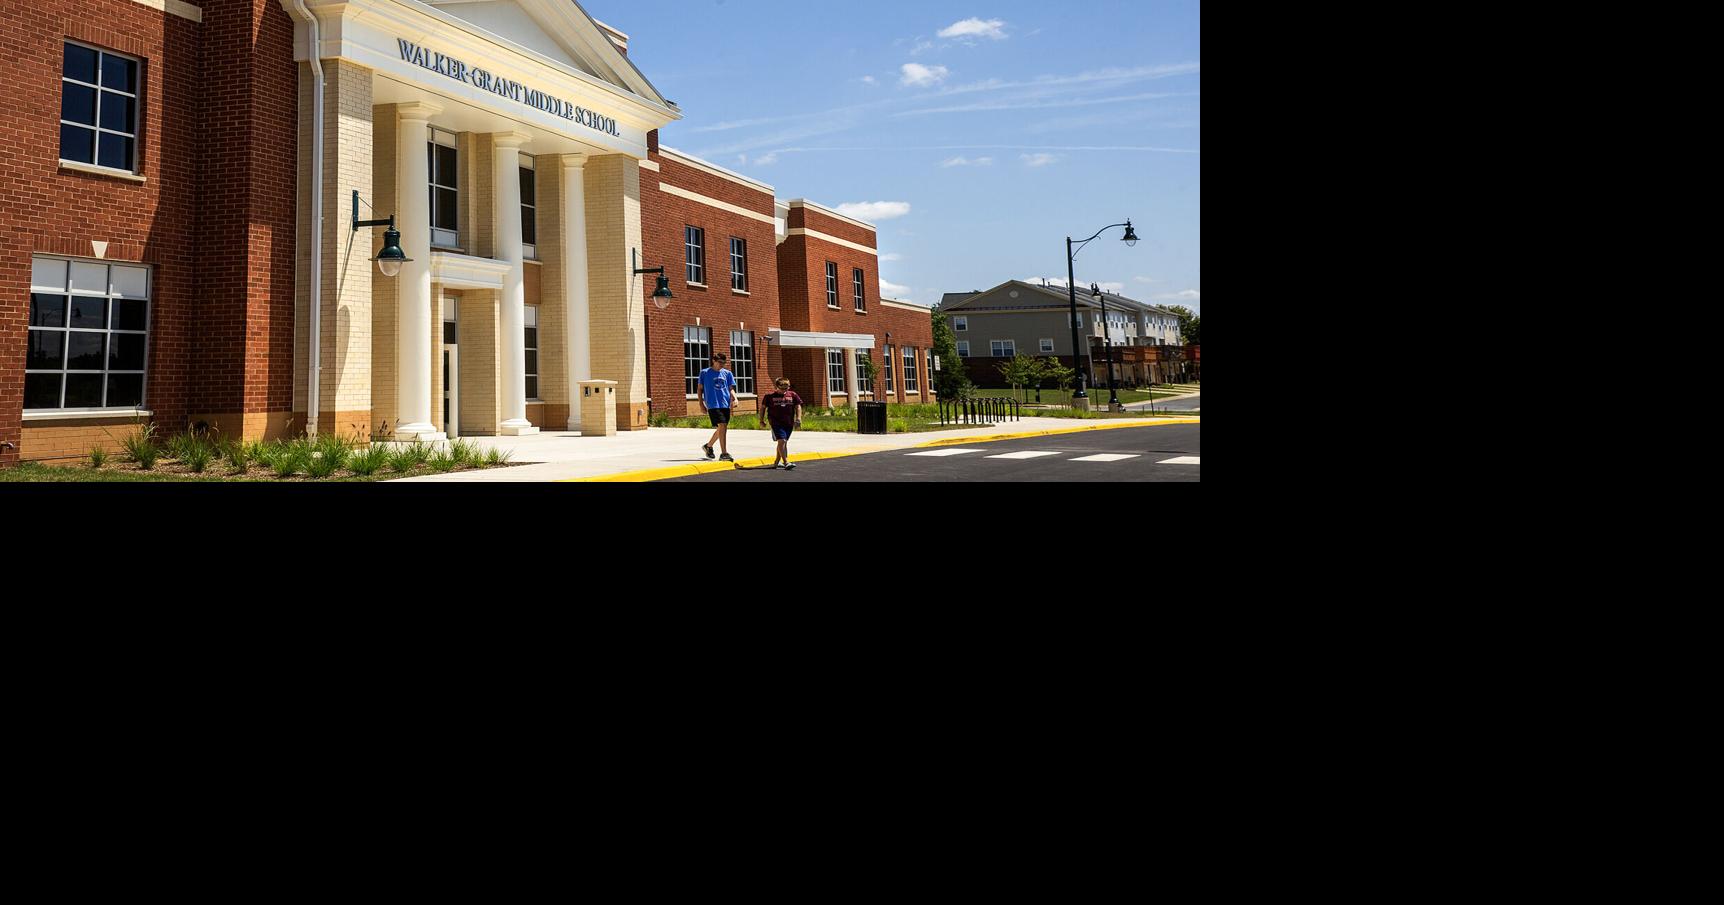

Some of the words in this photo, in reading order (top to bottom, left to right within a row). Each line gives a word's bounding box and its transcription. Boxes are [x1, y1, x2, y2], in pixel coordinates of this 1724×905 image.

[397, 37, 522, 102] WALKER-GRANT
[523, 86, 573, 121] MIDDLE
[575, 105, 620, 137] SCHOOL
